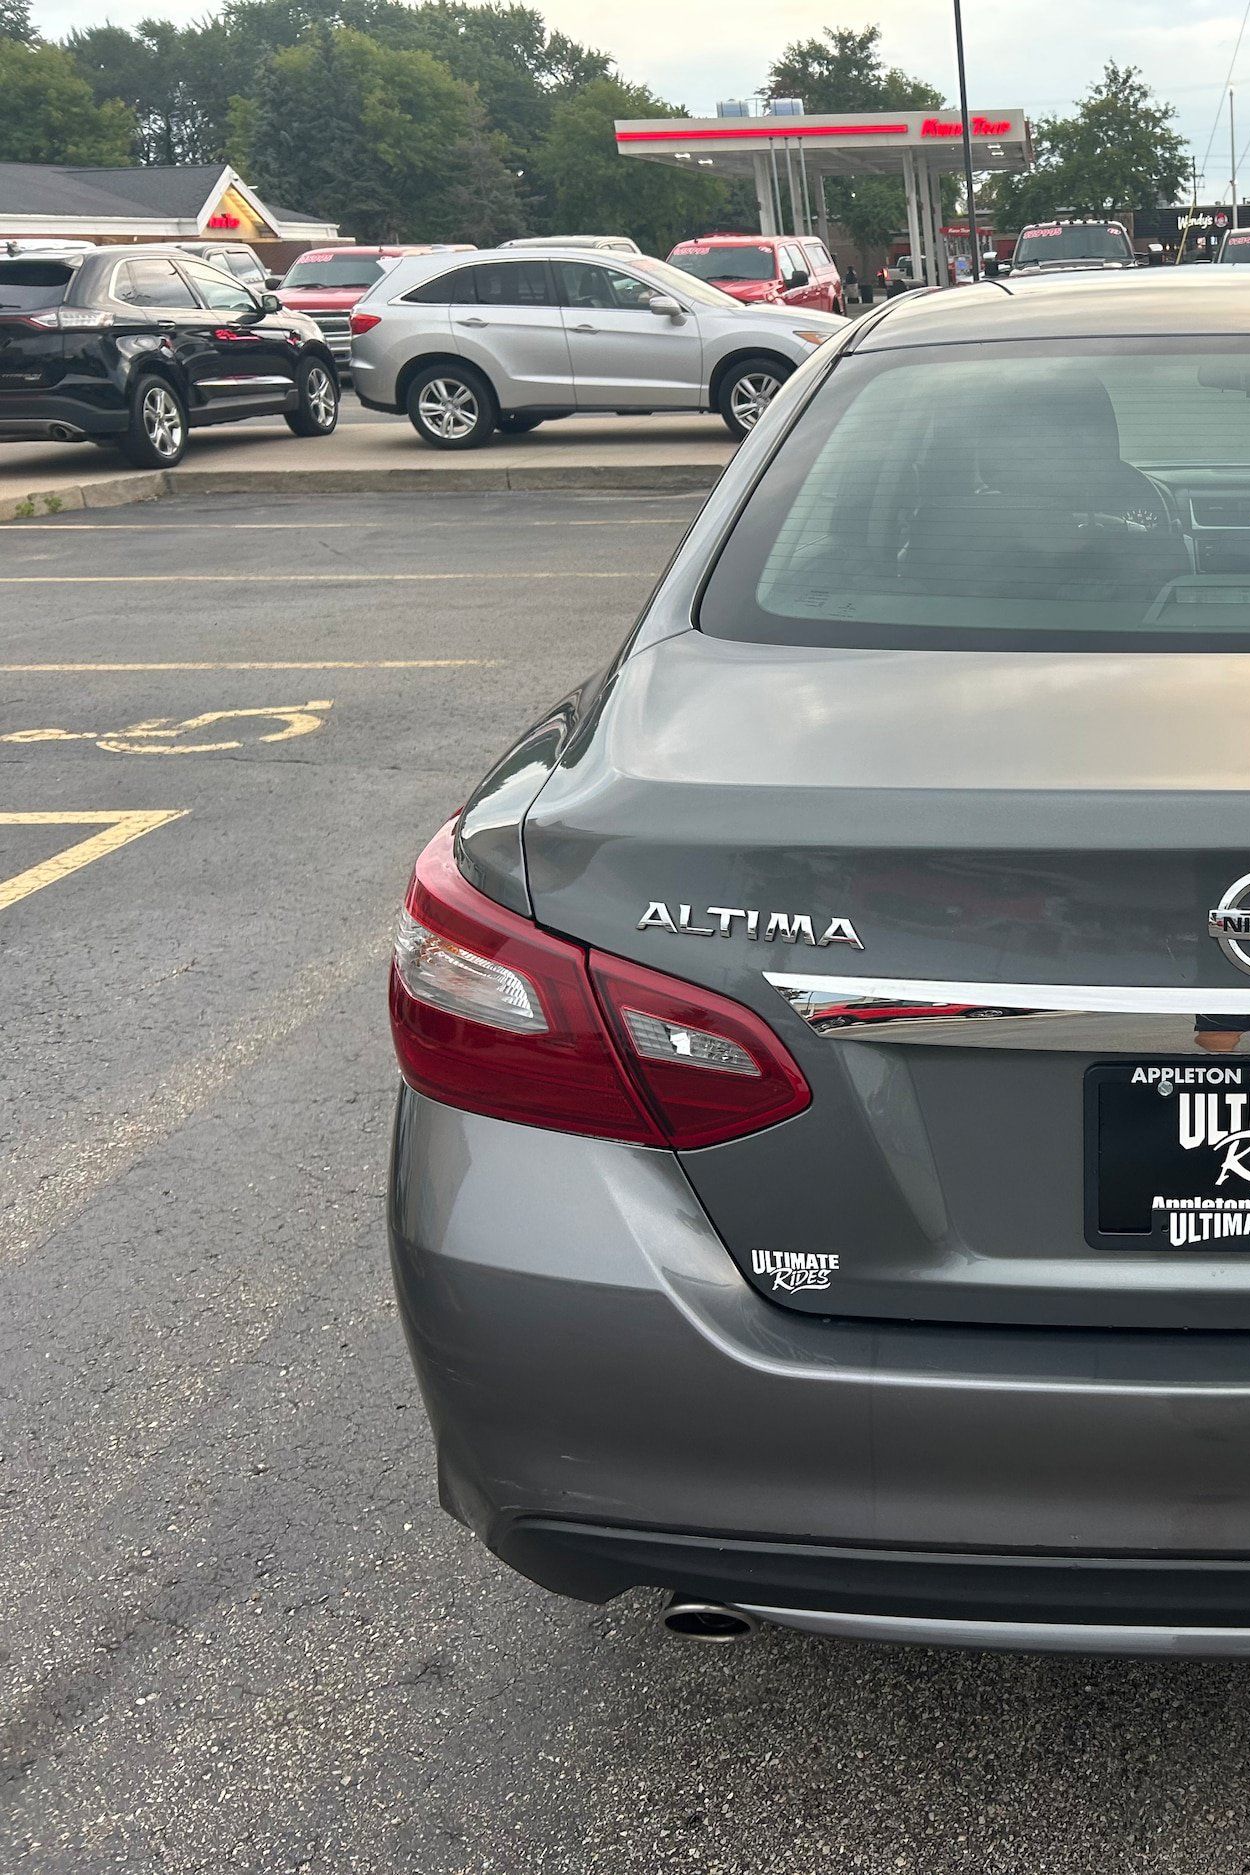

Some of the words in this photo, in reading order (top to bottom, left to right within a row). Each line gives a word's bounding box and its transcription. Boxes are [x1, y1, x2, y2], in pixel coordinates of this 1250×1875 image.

[636, 901, 865, 950] ALTIMA
[1131, 1067, 1242, 1084] APPLETON
[751, 1249, 840, 1275] ULTIMATE
